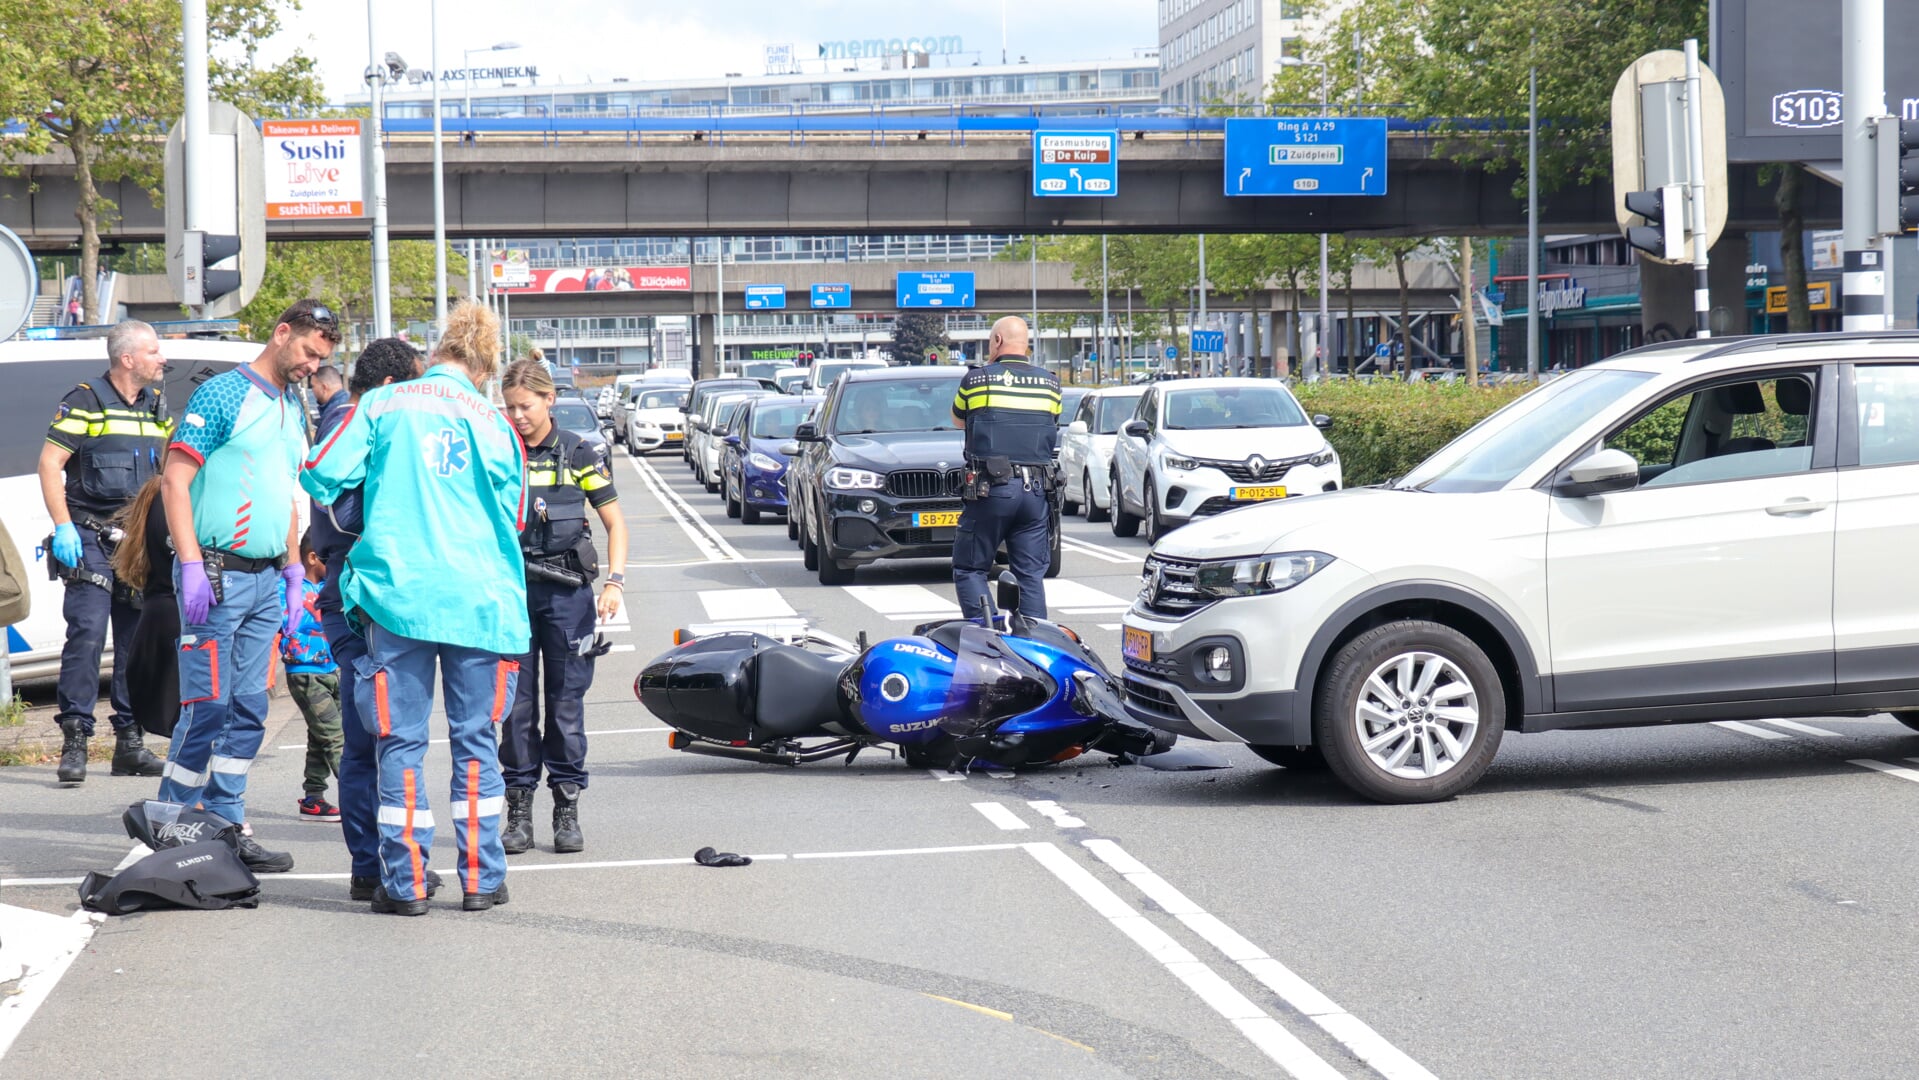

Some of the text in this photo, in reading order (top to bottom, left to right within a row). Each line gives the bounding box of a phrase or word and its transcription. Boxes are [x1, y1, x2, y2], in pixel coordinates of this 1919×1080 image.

[823, 35, 963, 59] memocom
[1779, 97, 1841, 121] S103
[268, 124, 356, 136] Takeaway & Delivery
[1277, 122, 1300, 133] Ring
[280, 139, 345, 160] Sushi
[1044, 138, 1107, 148] Erasmusbrug
[1057, 150, 1097, 162] De Kuip
[1290, 150, 1336, 162] Zuidplein
[287, 162, 340, 184] Live
[290, 189, 326, 198] Zuidplein
[278, 202, 352, 215] sushilive.nl
[394, 384, 497, 423] AMBULANCE
[1239, 488, 1280, 498] P-012-SL
[893, 643, 953, 663] SUZUKI
[176, 854, 214, 869] XLMOTO
